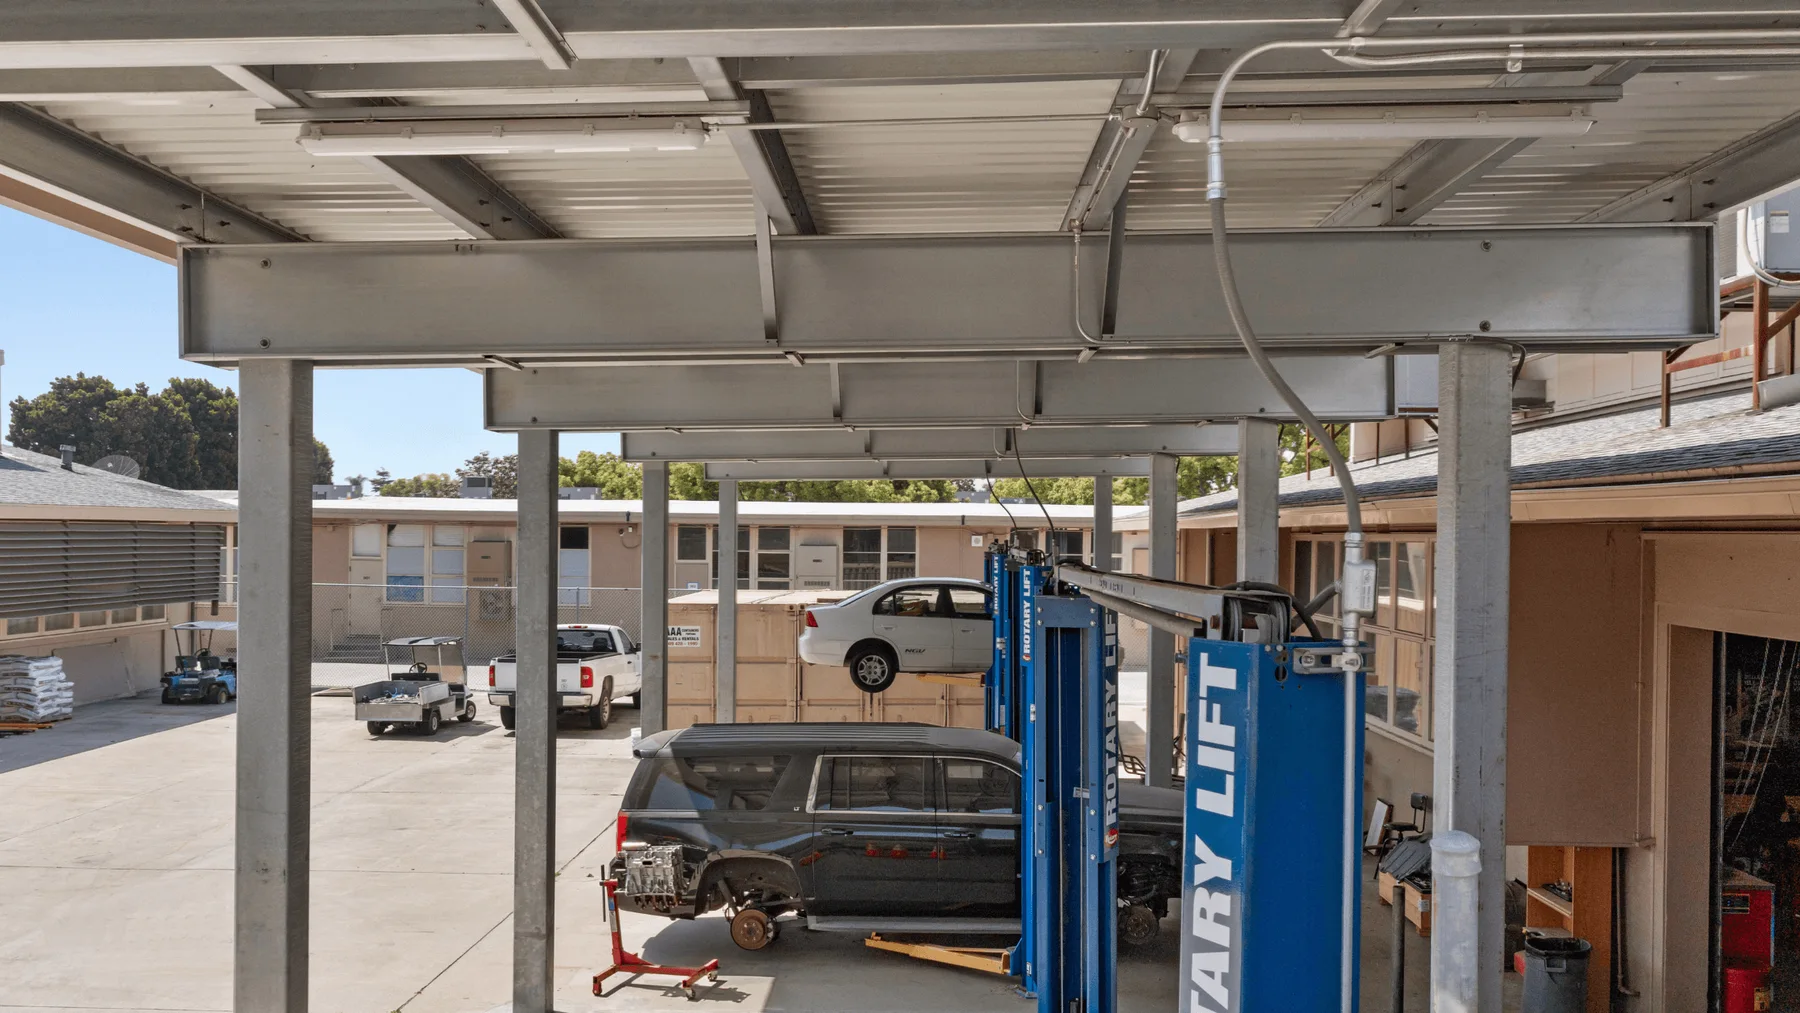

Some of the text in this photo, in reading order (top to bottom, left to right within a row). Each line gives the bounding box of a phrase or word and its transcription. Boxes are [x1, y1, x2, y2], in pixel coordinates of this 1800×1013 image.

[1023, 568, 1031, 654] ROTARY LIFT
[1105, 608, 1117, 826] ROTARY LIF
[1189, 652, 1237, 1013] TARY LIFT
